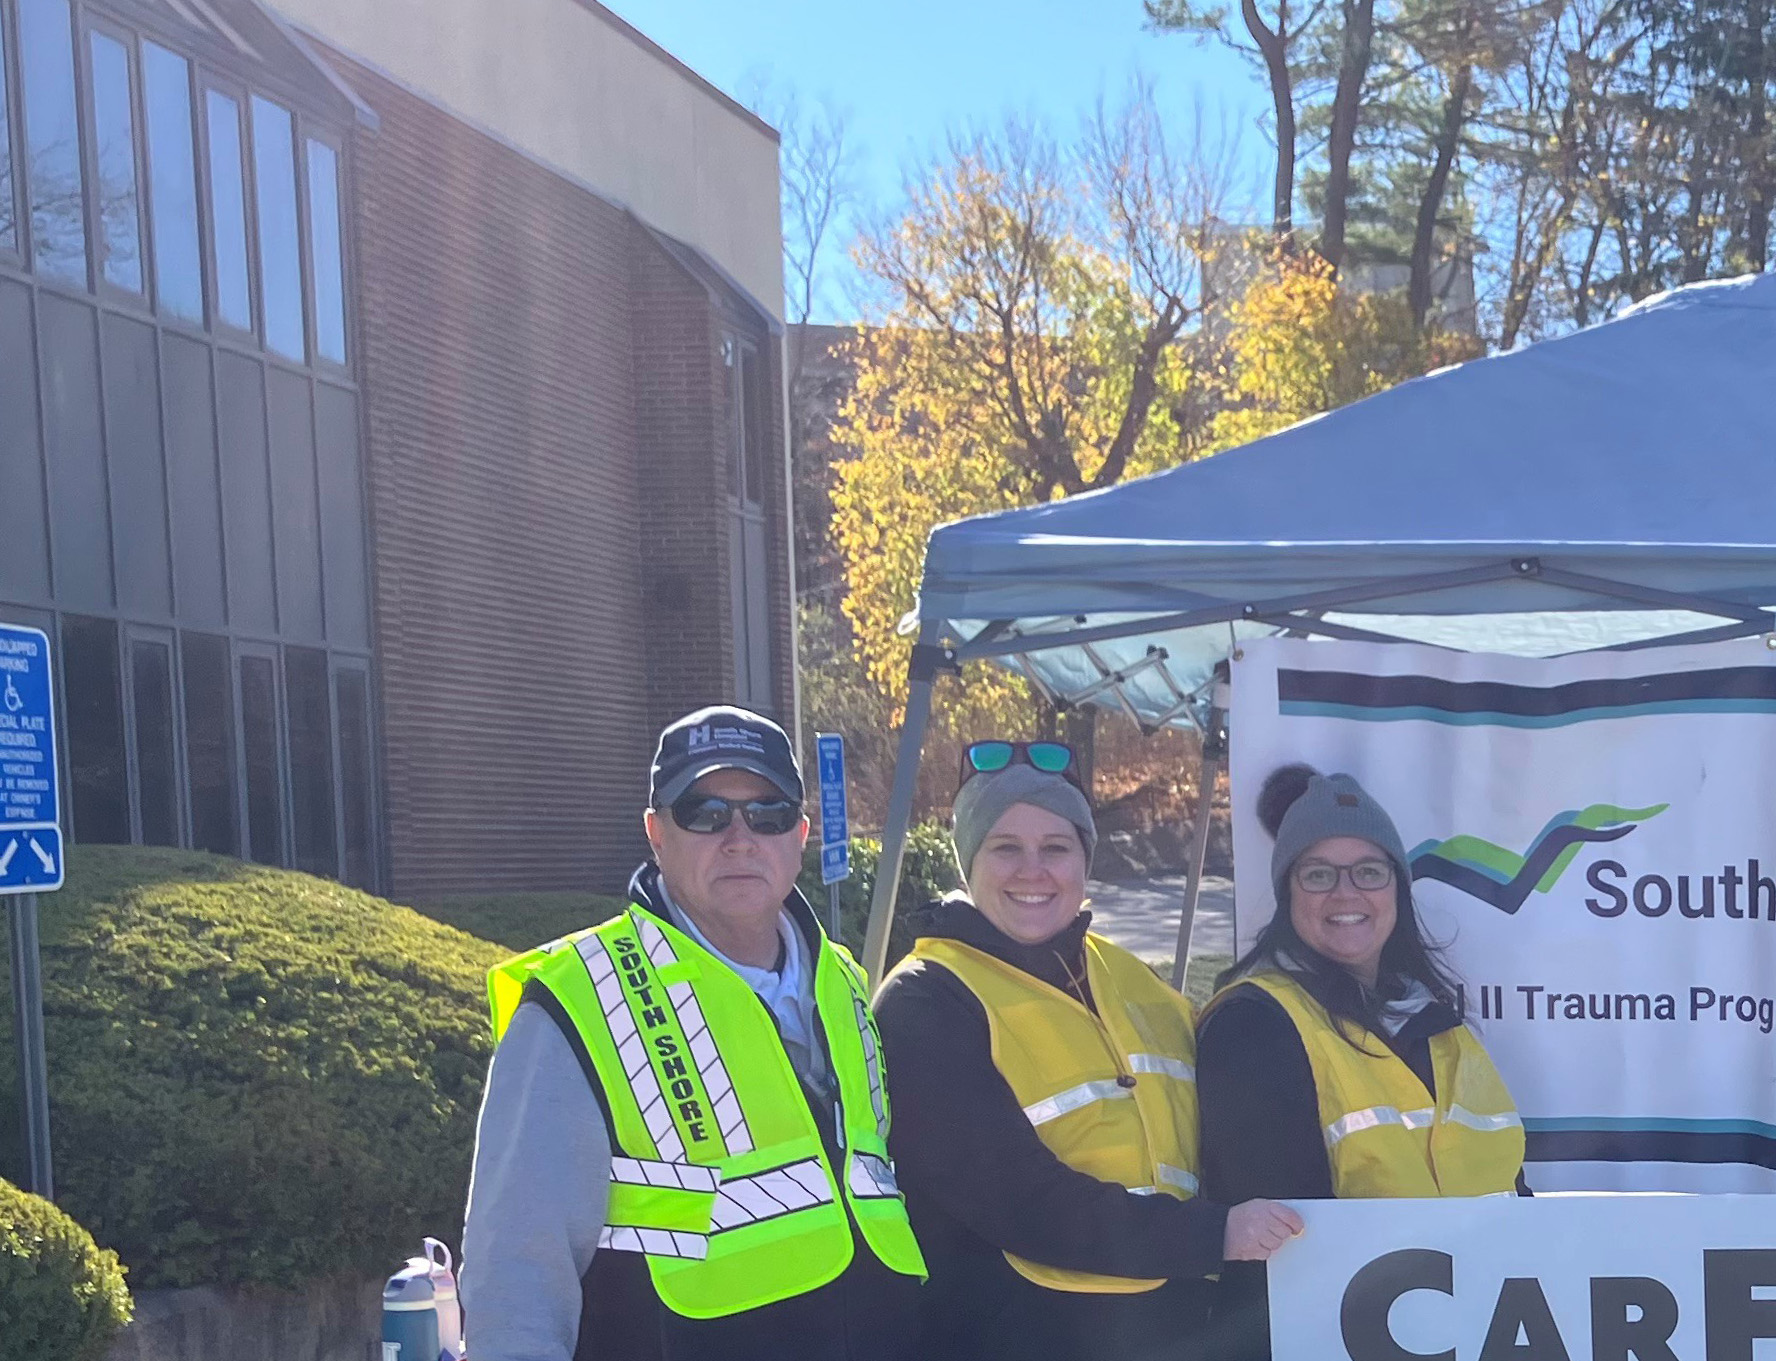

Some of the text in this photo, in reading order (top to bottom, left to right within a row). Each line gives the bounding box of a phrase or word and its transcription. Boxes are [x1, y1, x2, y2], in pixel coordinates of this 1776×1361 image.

[1584, 859, 1776, 921] South
[1516, 985, 1676, 1020] Trauma
[613, 937, 709, 1142] SOUTH SHORE
